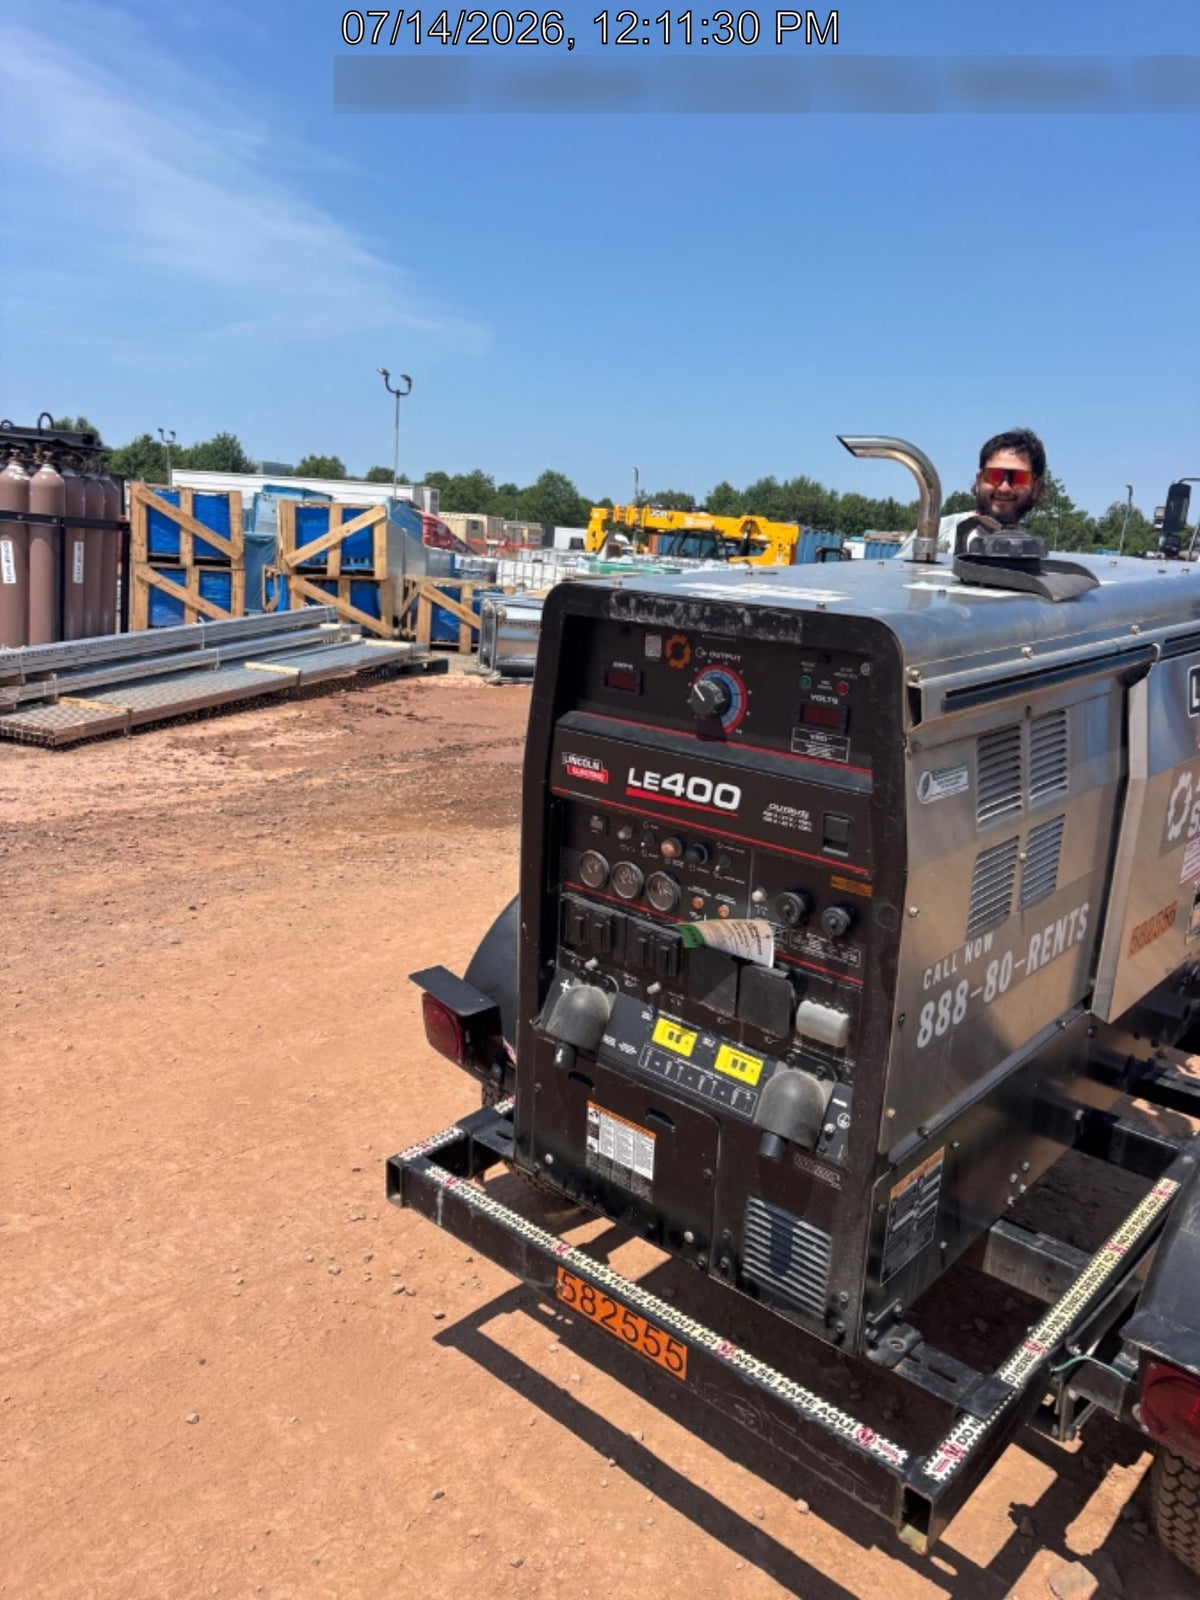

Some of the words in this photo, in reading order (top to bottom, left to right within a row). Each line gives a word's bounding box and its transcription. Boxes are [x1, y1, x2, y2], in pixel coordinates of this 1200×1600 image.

[709, 651, 742, 661] OUTPUT
[810, 694, 839, 705] VOLTS
[563, 753, 601, 770] LINCOLN
[627, 767, 741, 810] LE400
[917, 902, 1090, 1048] 888-80-RENTS
[923, 953, 958, 990] CALL
[965, 932, 994, 964] NOW
[562, 1271, 685, 1373] 582555
[609, 1275, 645, 1299] TENEZ
[647, 1296, 696, 1332] DEBOUT
[697, 1331, 717, 1344] ICI
[736, 1353, 756, 1369] NO
[756, 1368, 774, 1382] SE
[778, 1381, 818, 1408] PARE
[818, 1405, 856, 1431] AQUI
[956, 1427, 974, 1445] DO
[1013, 1352, 1036, 1379] HERE
[1039, 1329, 1053, 1344] NE
[1049, 1313, 1066, 1332] PAS
